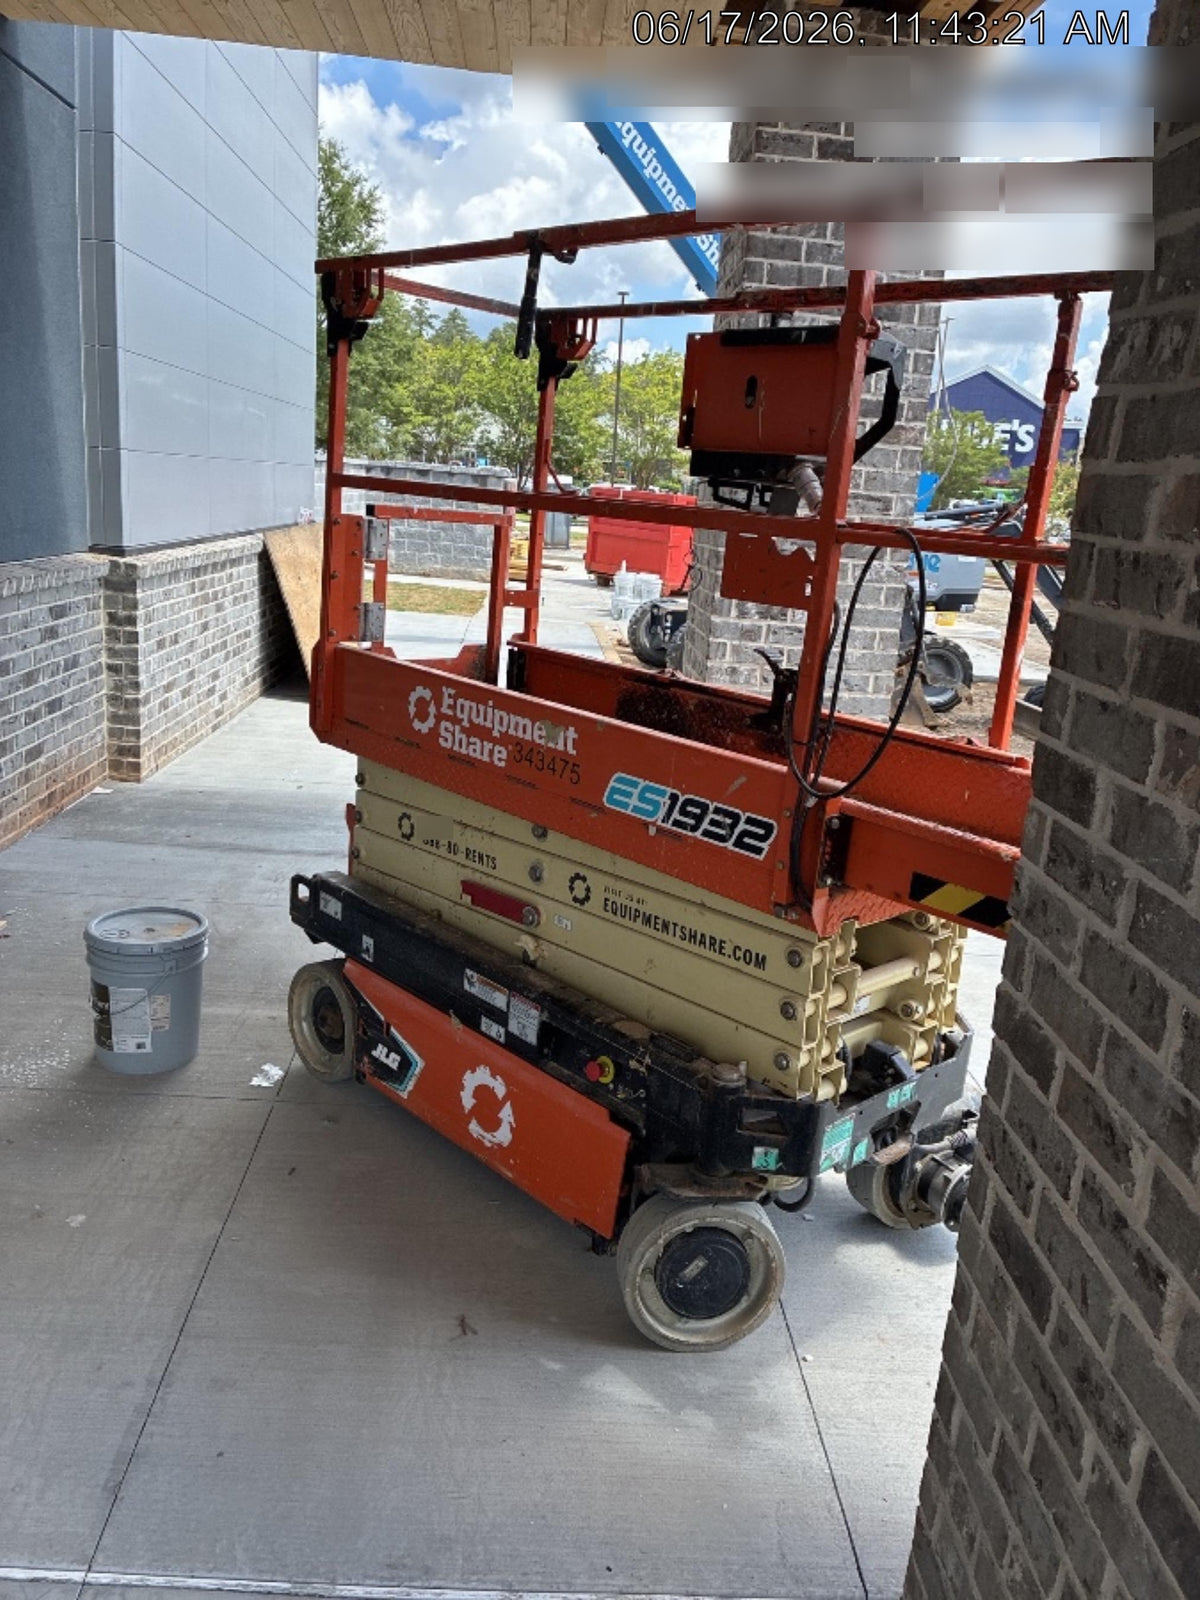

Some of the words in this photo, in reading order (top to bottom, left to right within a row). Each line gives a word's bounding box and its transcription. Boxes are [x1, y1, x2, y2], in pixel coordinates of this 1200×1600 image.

[438, 719, 508, 768] Share
[513, 741, 581, 785] 343475
[603, 772, 778, 861] ES1932
[602, 897, 768, 972] EQUIPMENTSHARE.COM
[370, 1043, 401, 1071] JLG
